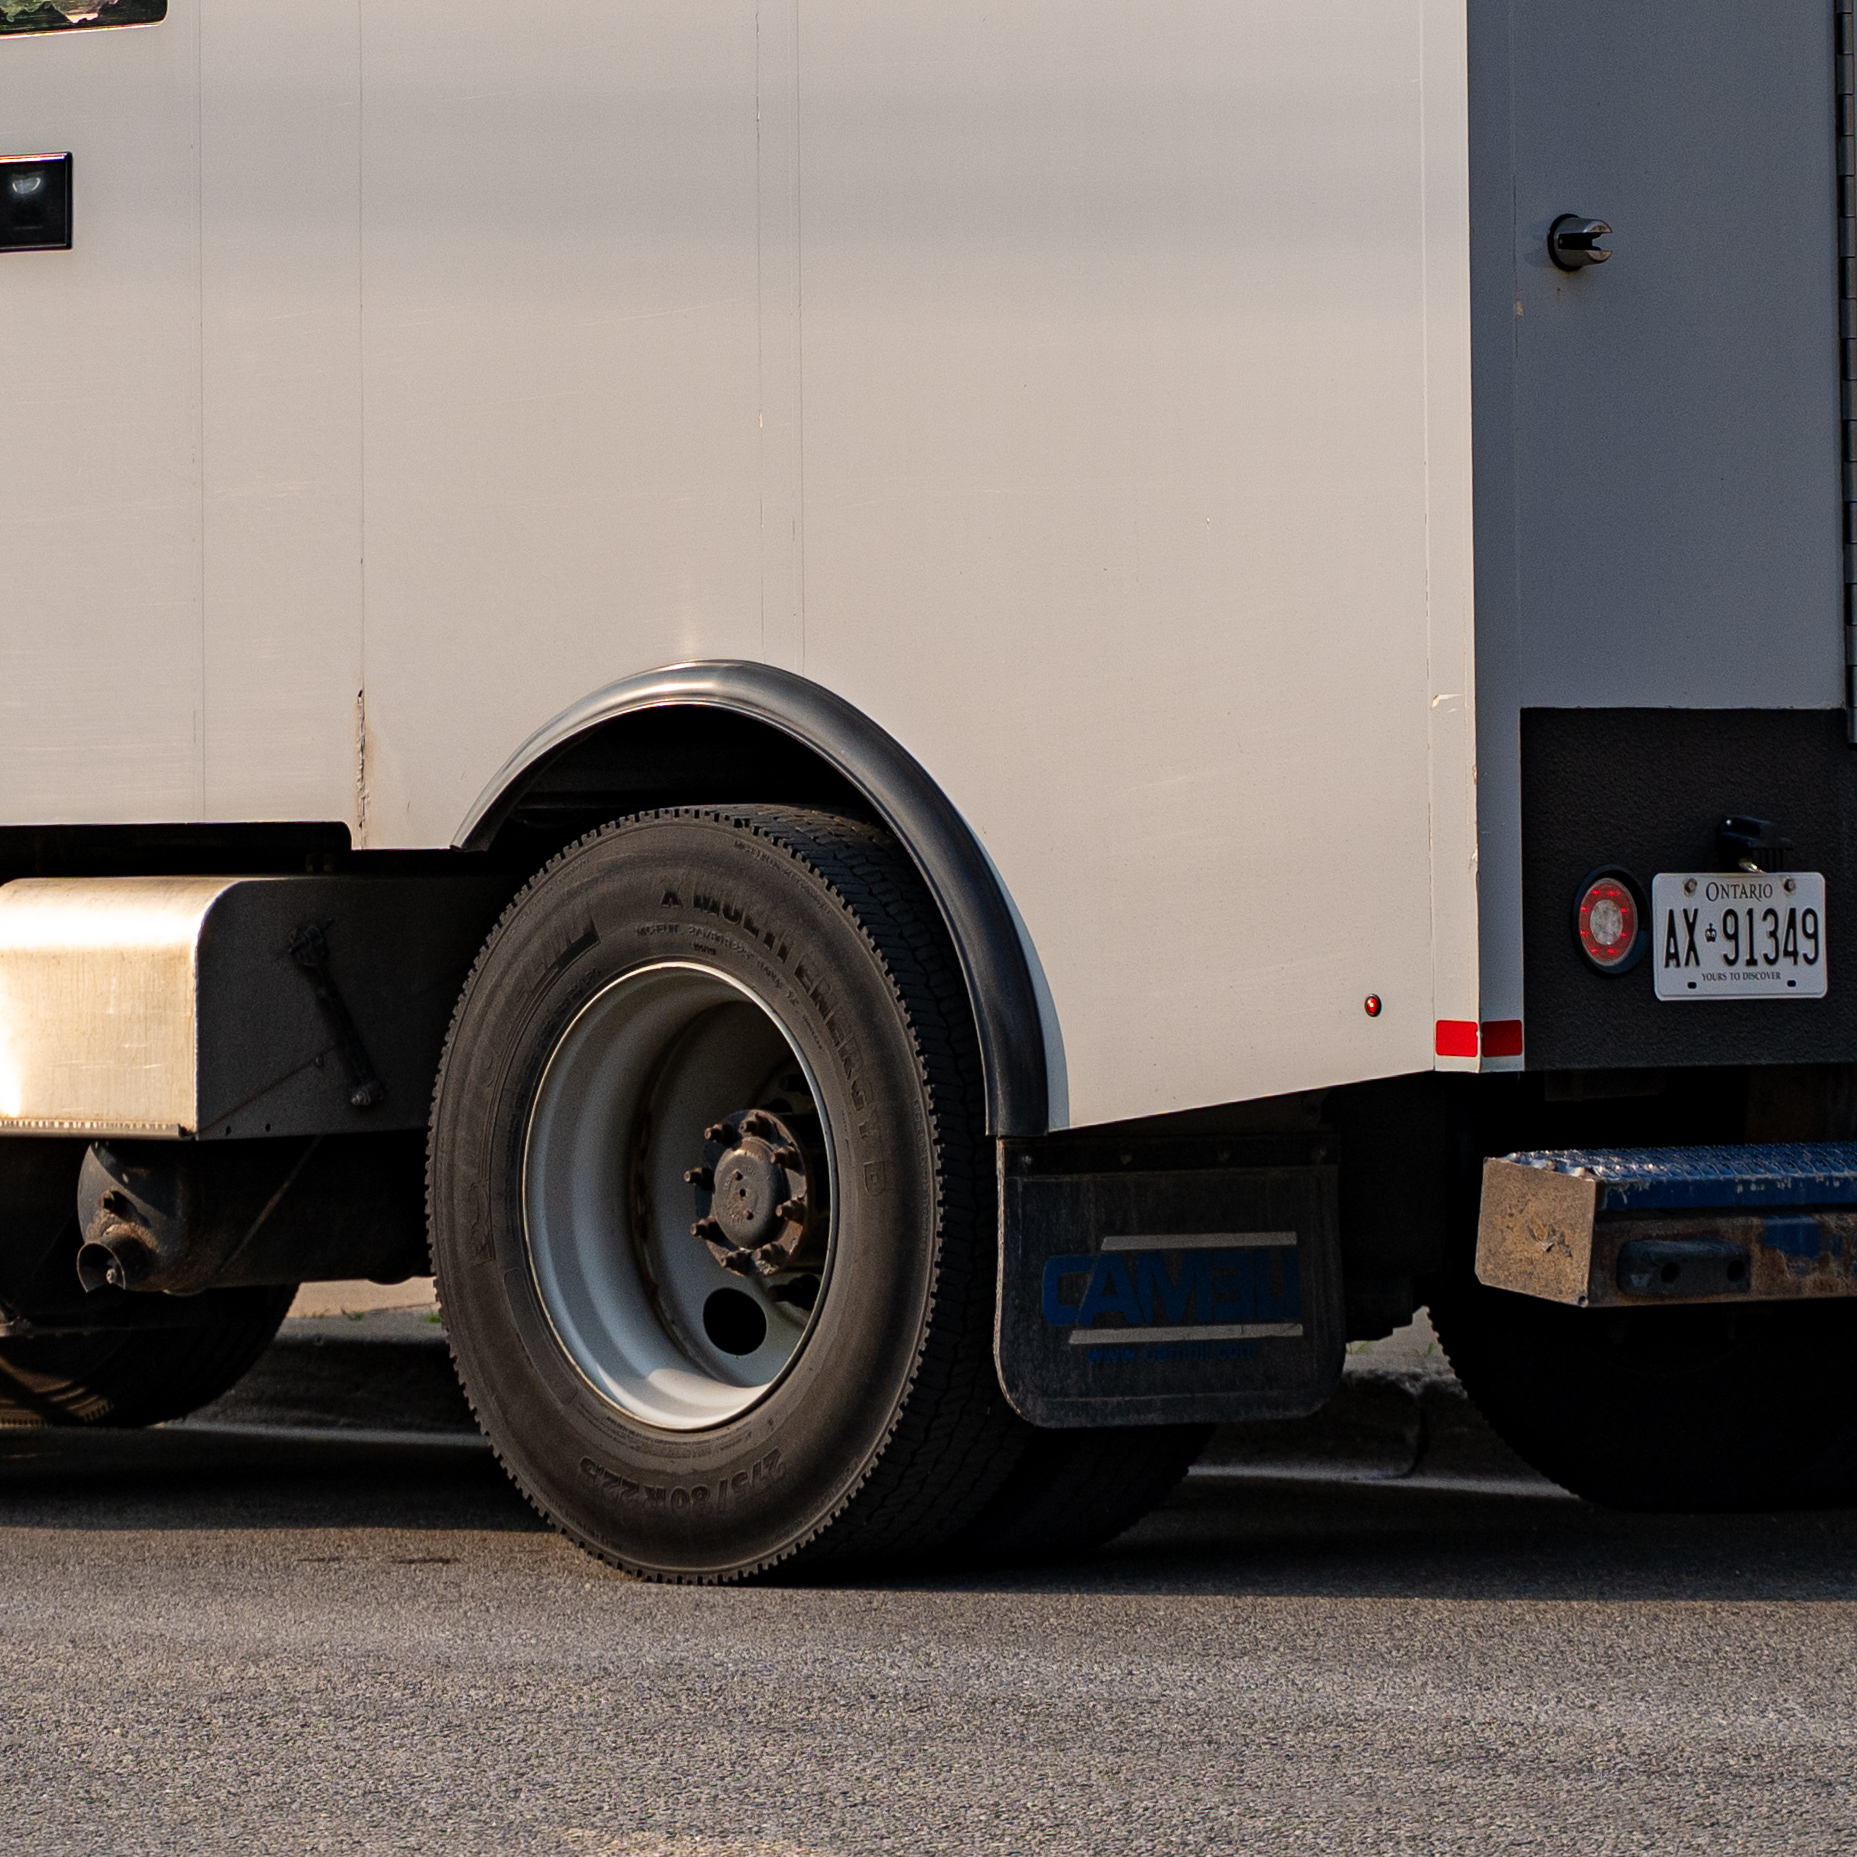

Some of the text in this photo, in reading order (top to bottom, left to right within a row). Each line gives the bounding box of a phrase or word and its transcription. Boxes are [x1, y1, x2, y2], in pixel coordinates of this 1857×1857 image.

[1664, 907, 1820, 969] AX 91349
[1701, 970, 1782, 982] YOURS TO DISCOVER
